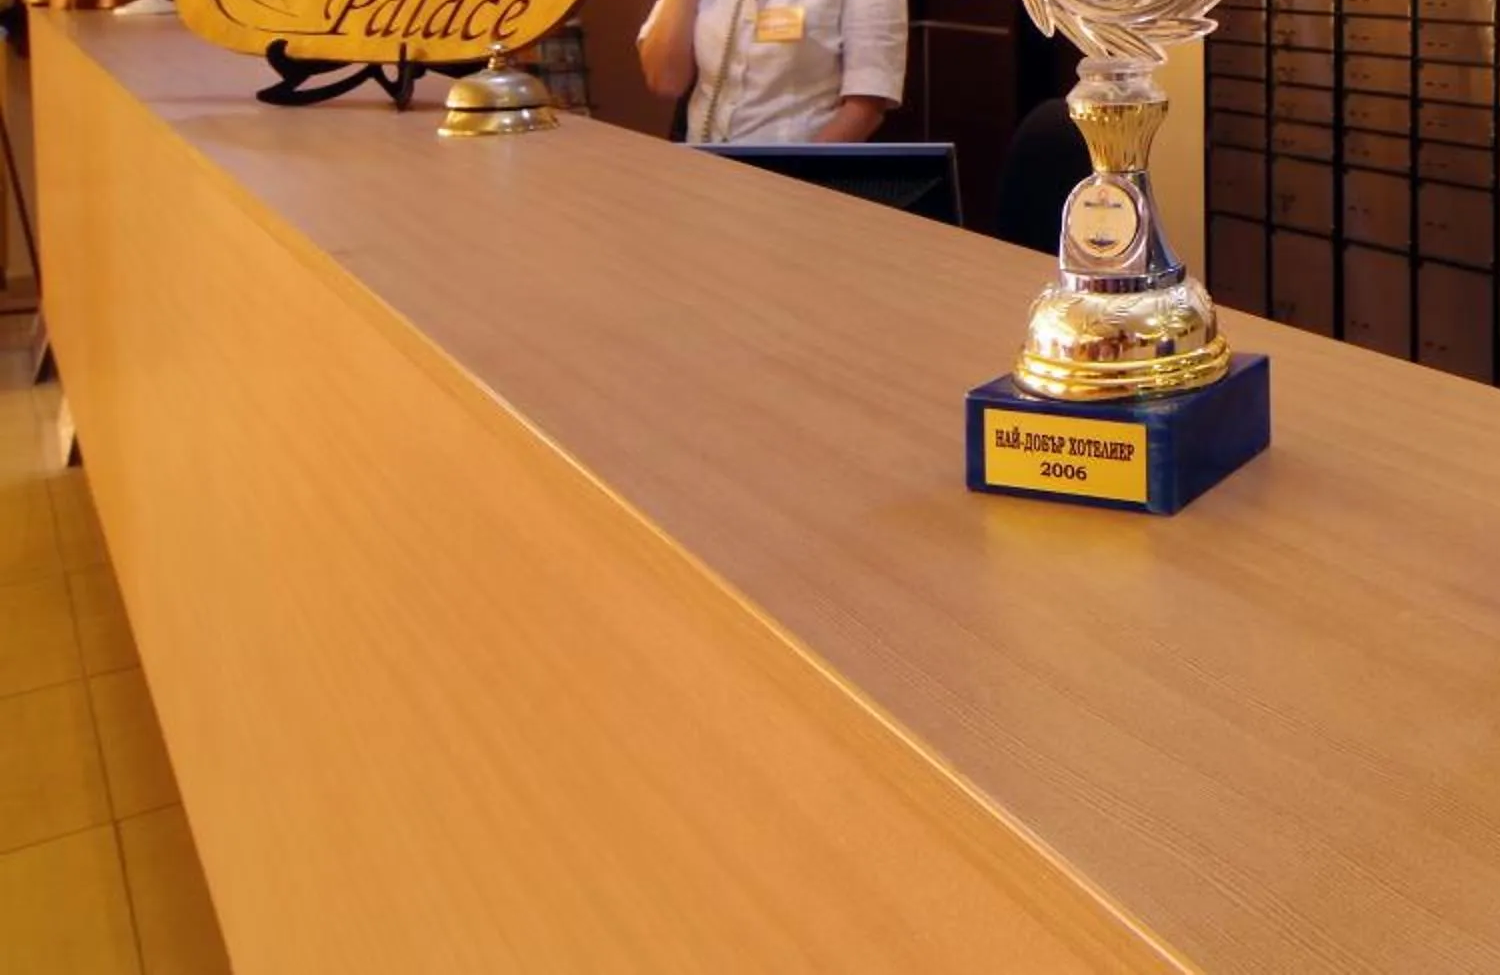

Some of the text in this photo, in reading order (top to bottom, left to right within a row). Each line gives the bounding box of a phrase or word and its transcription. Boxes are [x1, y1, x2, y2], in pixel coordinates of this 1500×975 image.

[995, 426, 1135, 462] НАЙ-ДОБЪР ХОТЕЛИЕР
[1040, 461, 1088, 481] 2006
